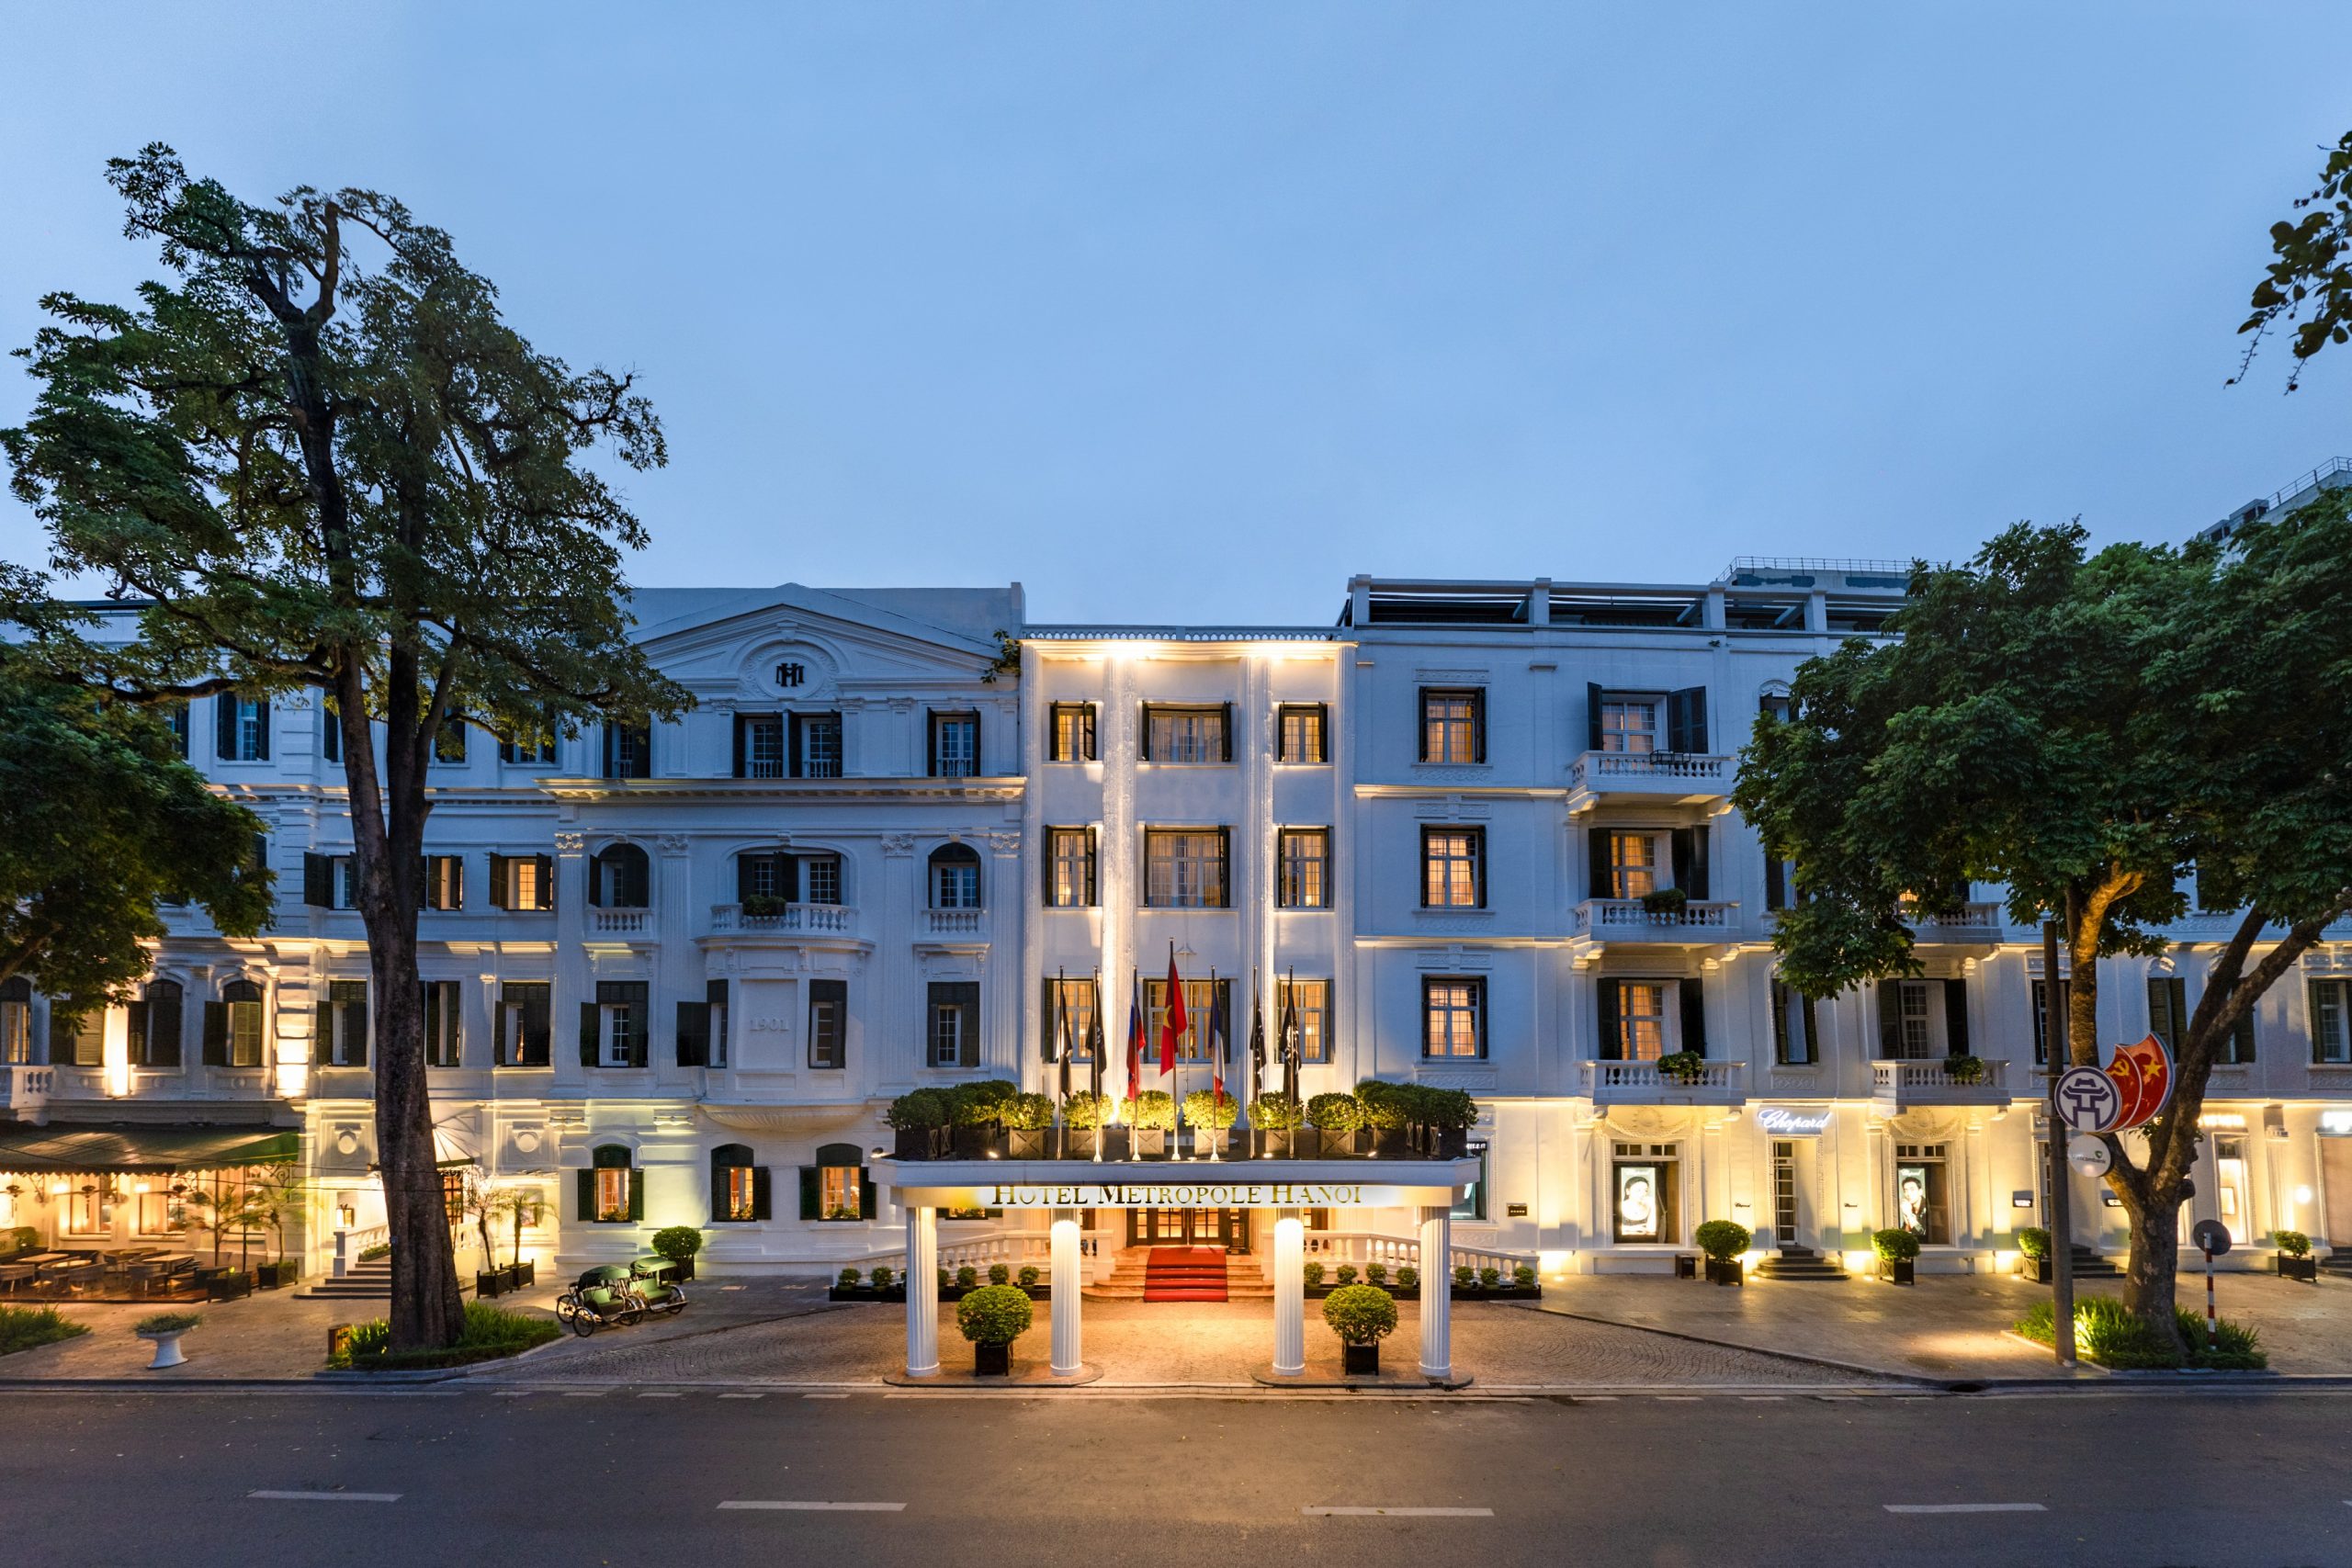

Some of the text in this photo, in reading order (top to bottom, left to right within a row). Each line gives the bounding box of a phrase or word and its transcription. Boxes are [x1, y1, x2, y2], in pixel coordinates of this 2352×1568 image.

[749, 1017, 789, 1032] 1901
[1758, 1109, 1832, 1132] Chopard
[992, 1184, 1362, 1204] HOTEL METROPOLE HANOI
